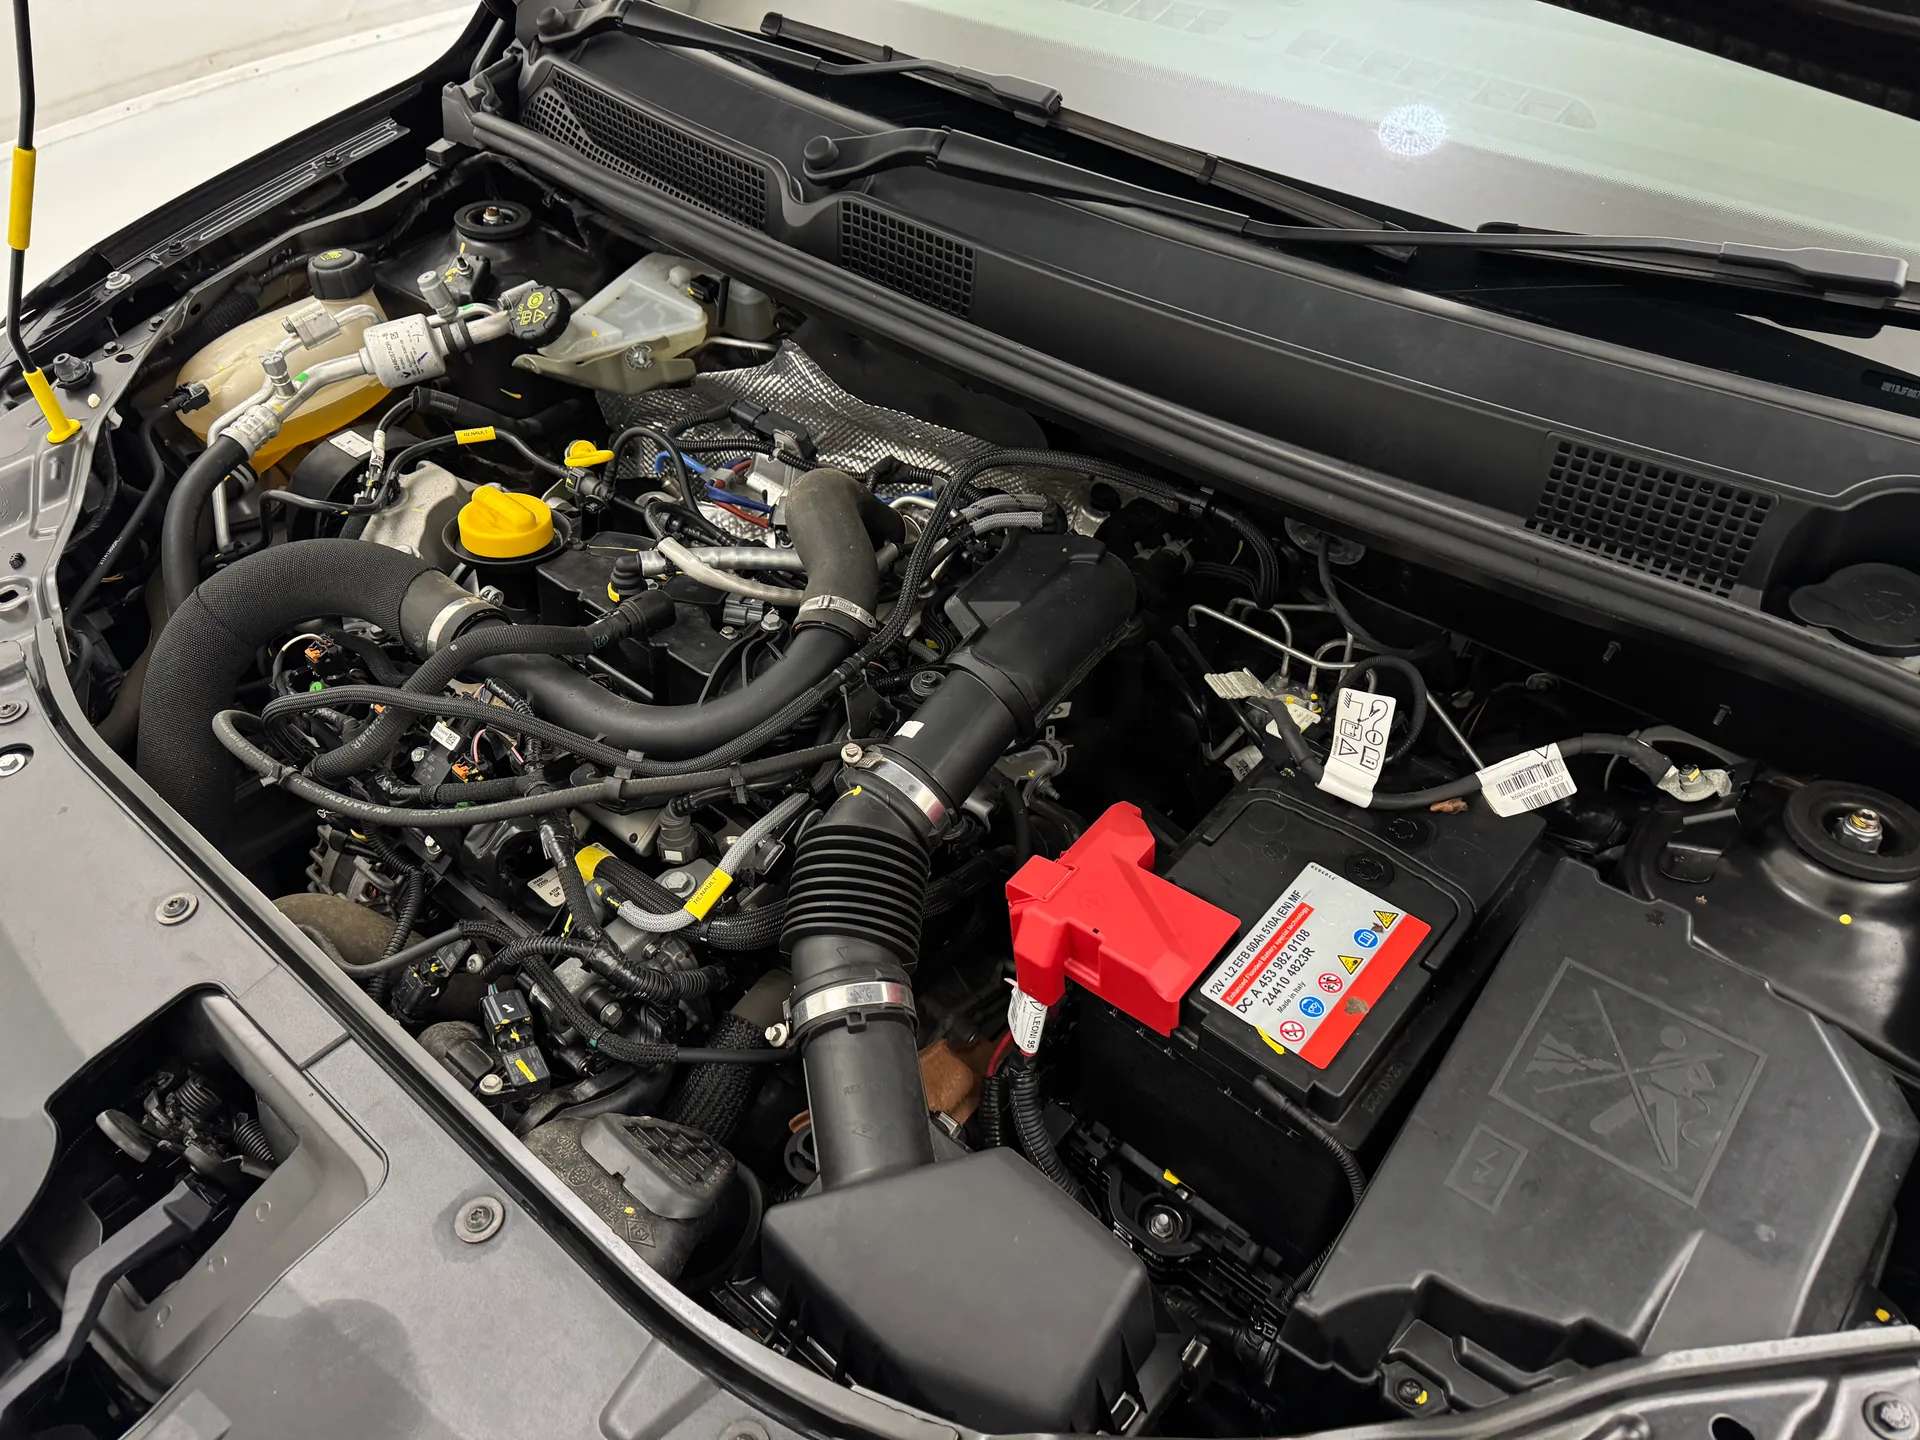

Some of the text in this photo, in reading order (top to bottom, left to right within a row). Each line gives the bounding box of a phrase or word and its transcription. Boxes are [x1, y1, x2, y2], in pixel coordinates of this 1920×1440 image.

[693, 876, 717, 904] RENAULT
[1209, 979, 1225, 996] 12V
[1223, 964, 1238, 979] L2
[1233, 949, 1251, 968] EFB
[1247, 933, 1267, 953] 60Ah
[1261, 914, 1282, 937] 510A
[1277, 900, 1296, 919] (EN)
[1288, 889, 1302, 904] MF
[1226, 906, 1310, 1002] Enhanced Flooded Battery special technology
[1250, 986, 1262, 999] A
[1258, 968, 1277, 989] 453
[1272, 951, 1291, 971] 982
[1287, 927, 1311, 953] 0108
[1262, 945, 1315, 1007] 24410 4823R
[1276, 999, 1291, 1013] Made
[1293, 980, 1307, 994] Italy
[1026, 1015, 1041, 1049] LEONI 95
